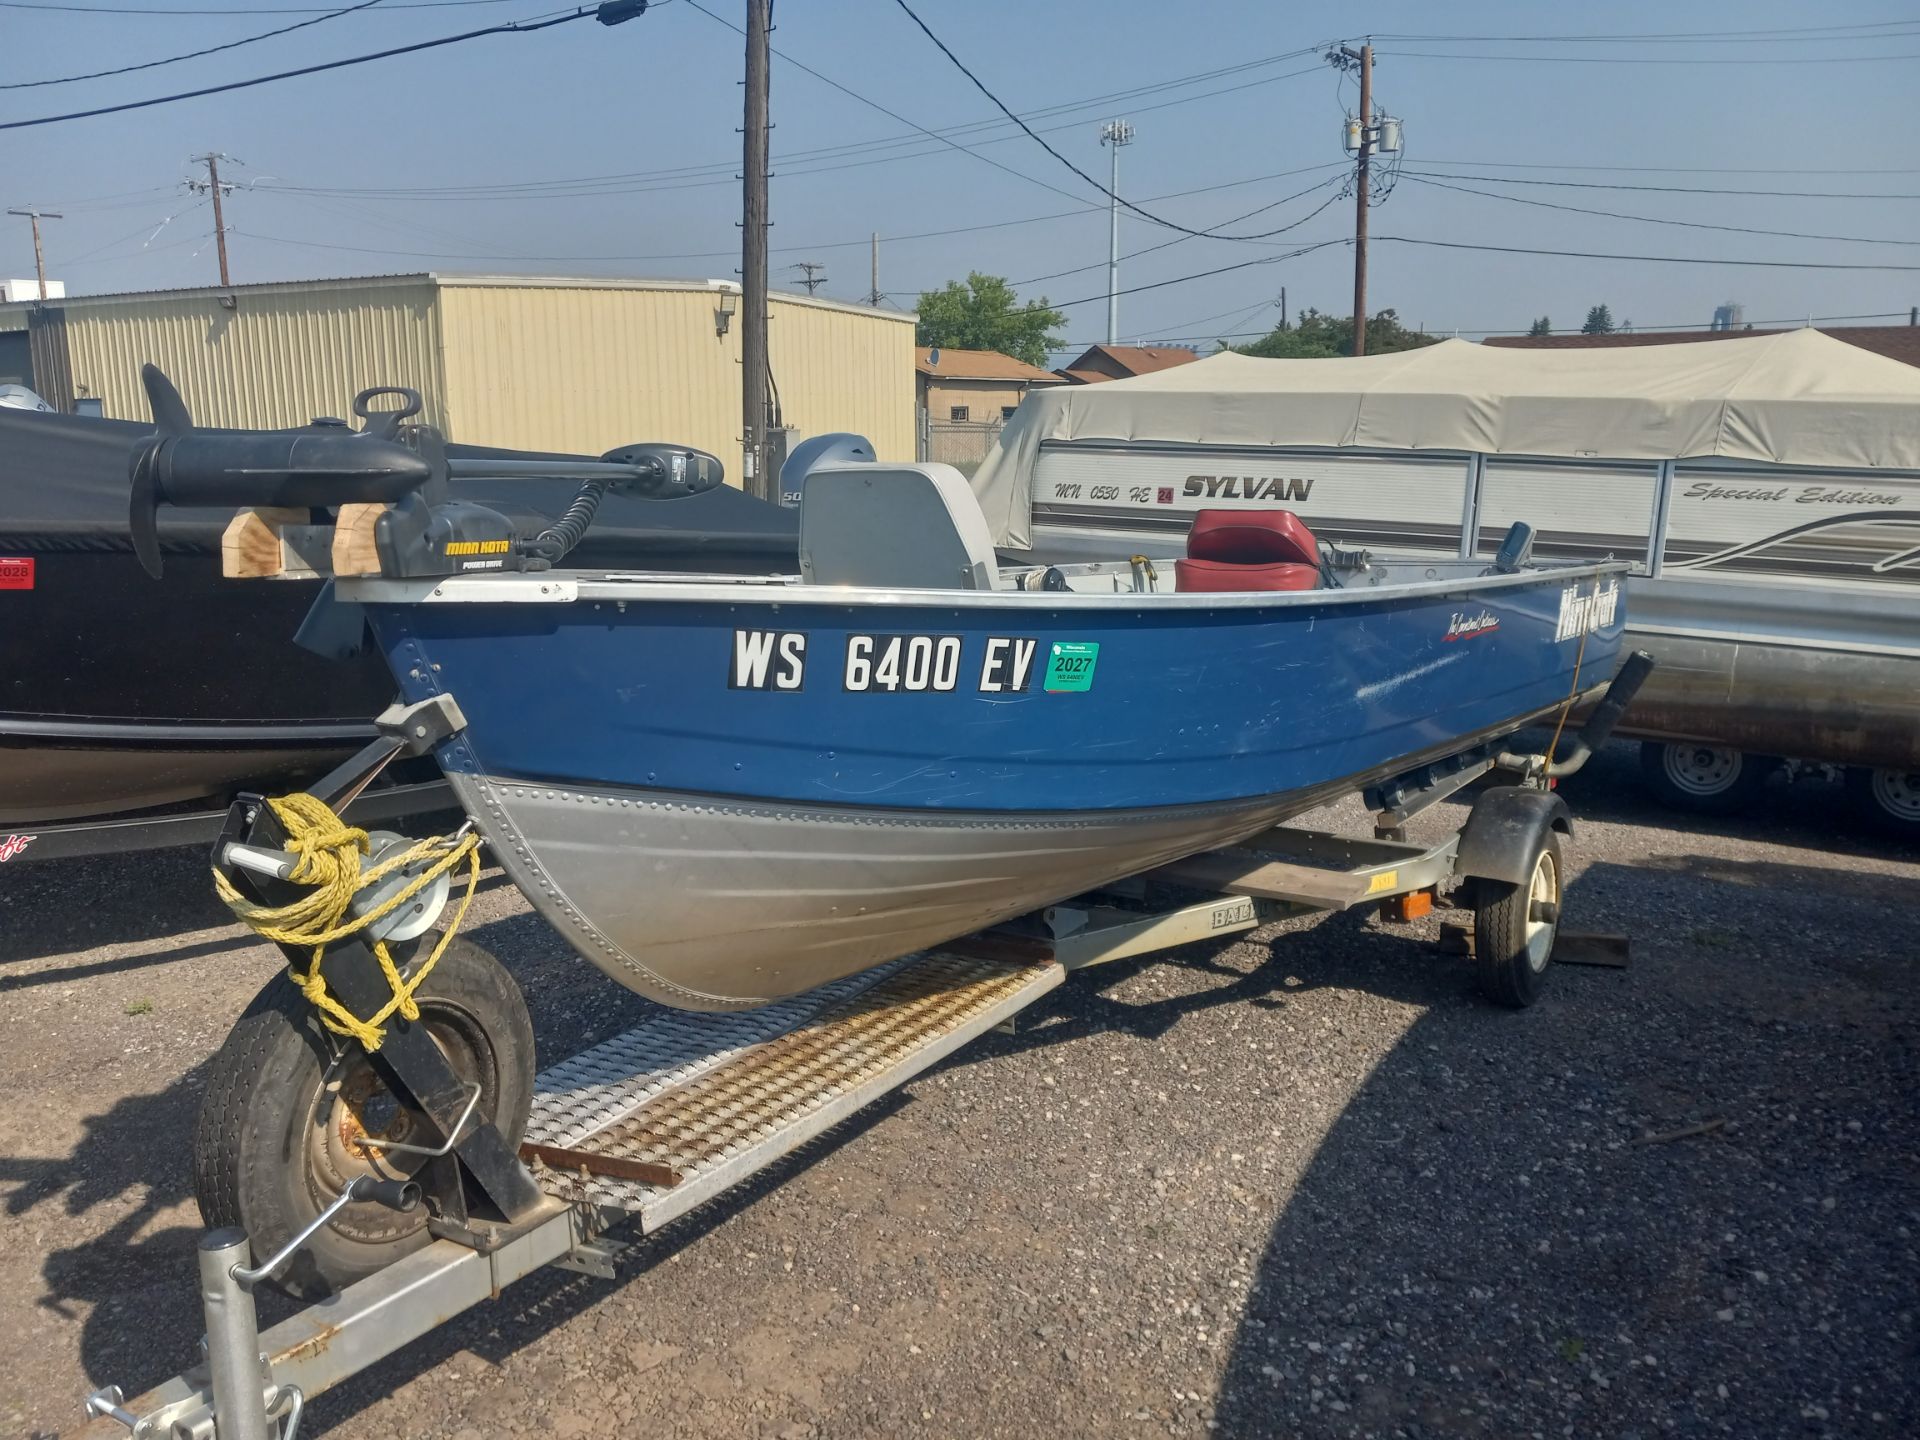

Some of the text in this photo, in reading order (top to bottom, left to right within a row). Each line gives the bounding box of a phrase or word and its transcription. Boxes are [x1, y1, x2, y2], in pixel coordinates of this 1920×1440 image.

[783, 492, 802, 501] 50
[1055, 483, 1152, 503] MN 0530 HE
[1158, 490, 1173, 501] 24
[1182, 475, 1314, 502] SYLVAN
[1683, 482, 1902, 505] Special Edition
[480, 540, 509, 554] KOTA
[735, 630, 1036, 692] WS 6400 EV
[1054, 657, 1093, 672] 2027
